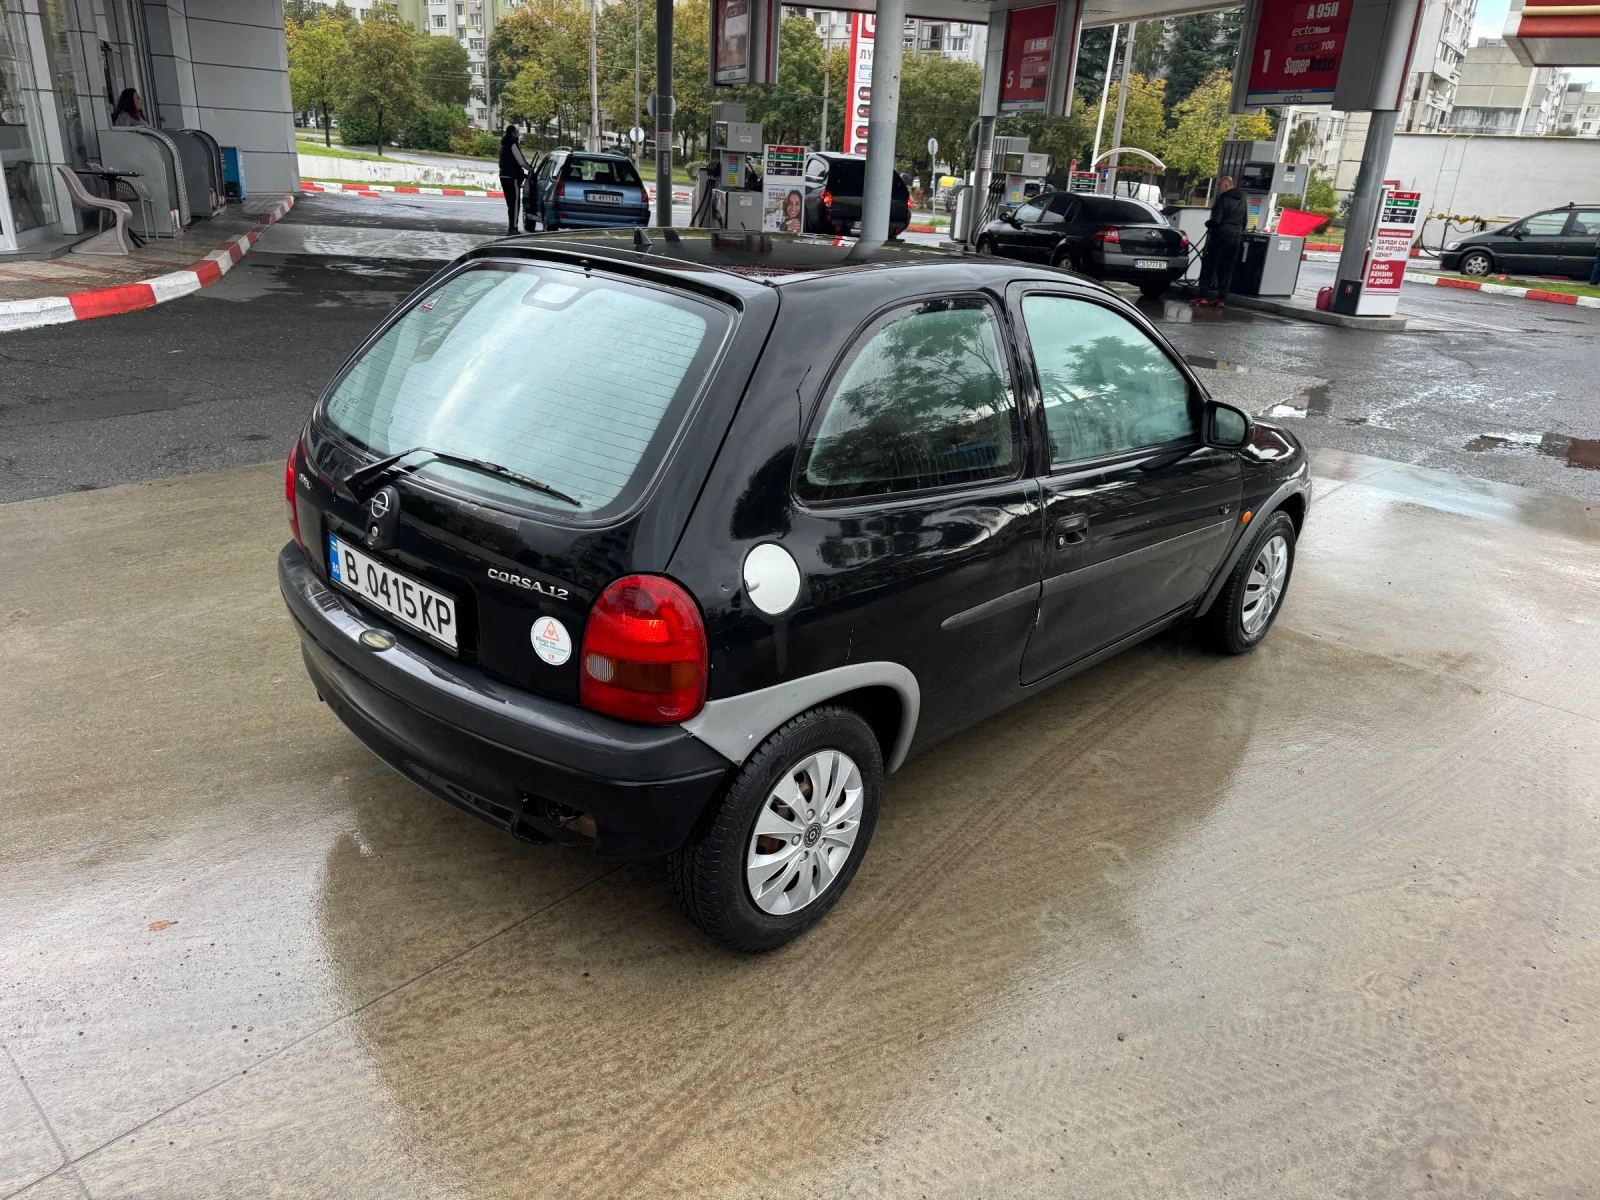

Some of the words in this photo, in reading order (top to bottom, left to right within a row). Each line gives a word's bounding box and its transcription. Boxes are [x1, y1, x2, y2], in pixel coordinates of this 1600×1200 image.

[1306, 4, 1315, 20] A
[1321, 40, 1336, 50] 100
[1262, 48, 1271, 74] 1
[1006, 70, 1014, 88] 5
[1283, 94, 1303, 103] ecto
[344, 549, 359, 585] B
[487, 568, 543, 593] CORSA
